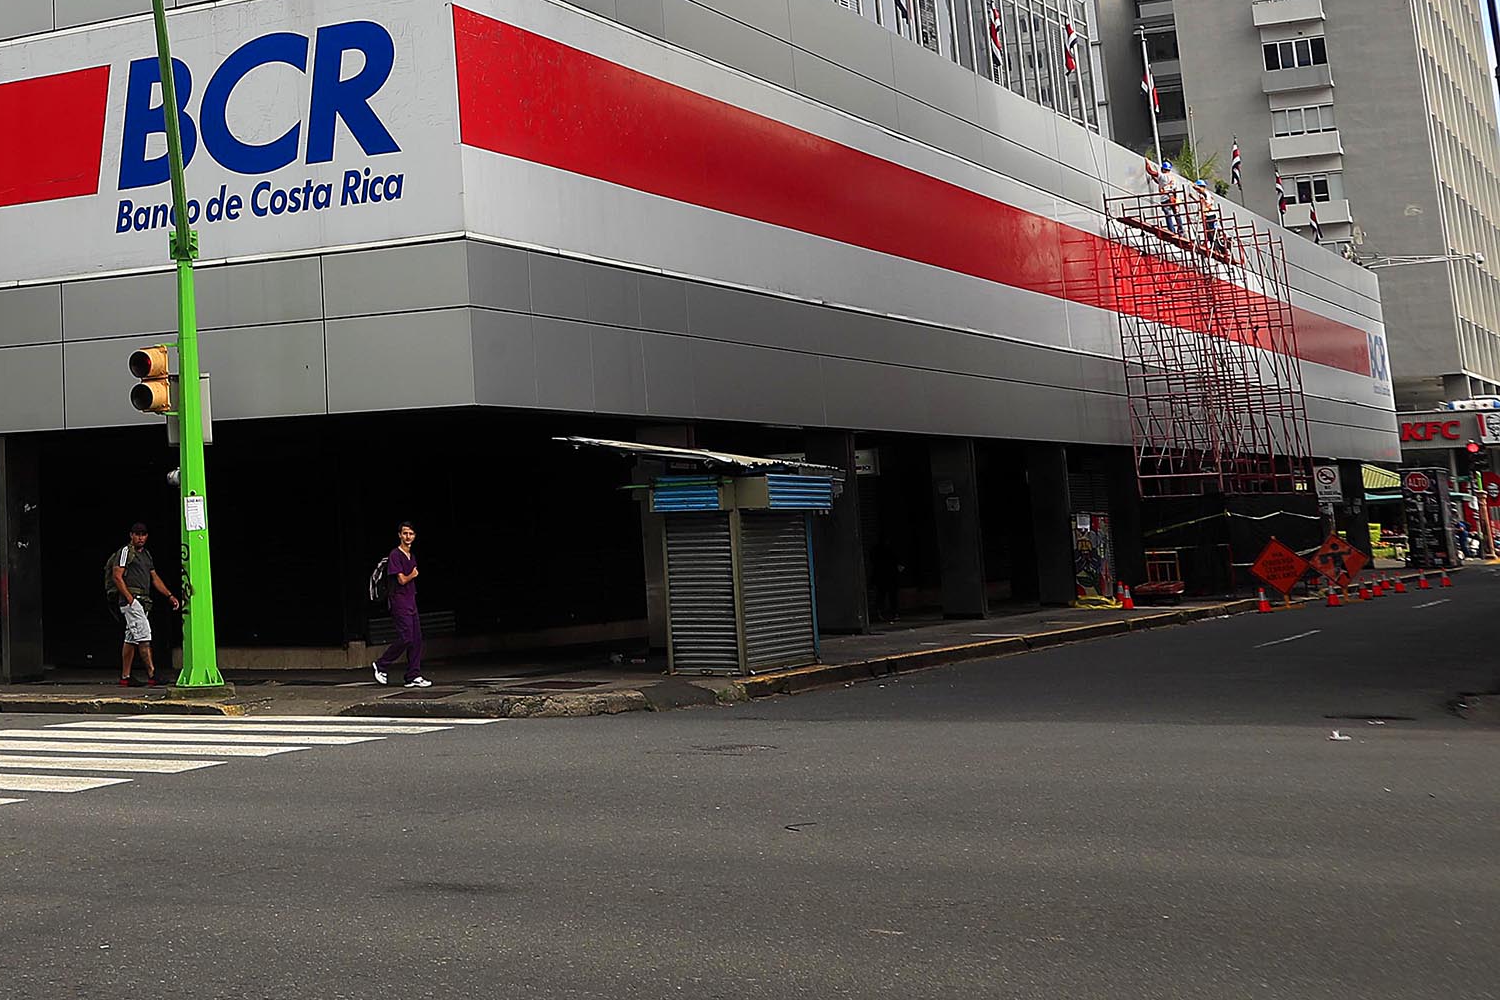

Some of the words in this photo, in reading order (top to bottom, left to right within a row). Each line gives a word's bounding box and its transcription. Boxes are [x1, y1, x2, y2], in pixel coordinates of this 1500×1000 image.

[117, 19, 403, 191] BCR
[205, 184, 243, 223] de
[251, 180, 333, 217] Costa
[340, 166, 405, 206] Rica
[1400, 420, 1461, 442] KFC
[1408, 477, 1428, 489] ALTO
